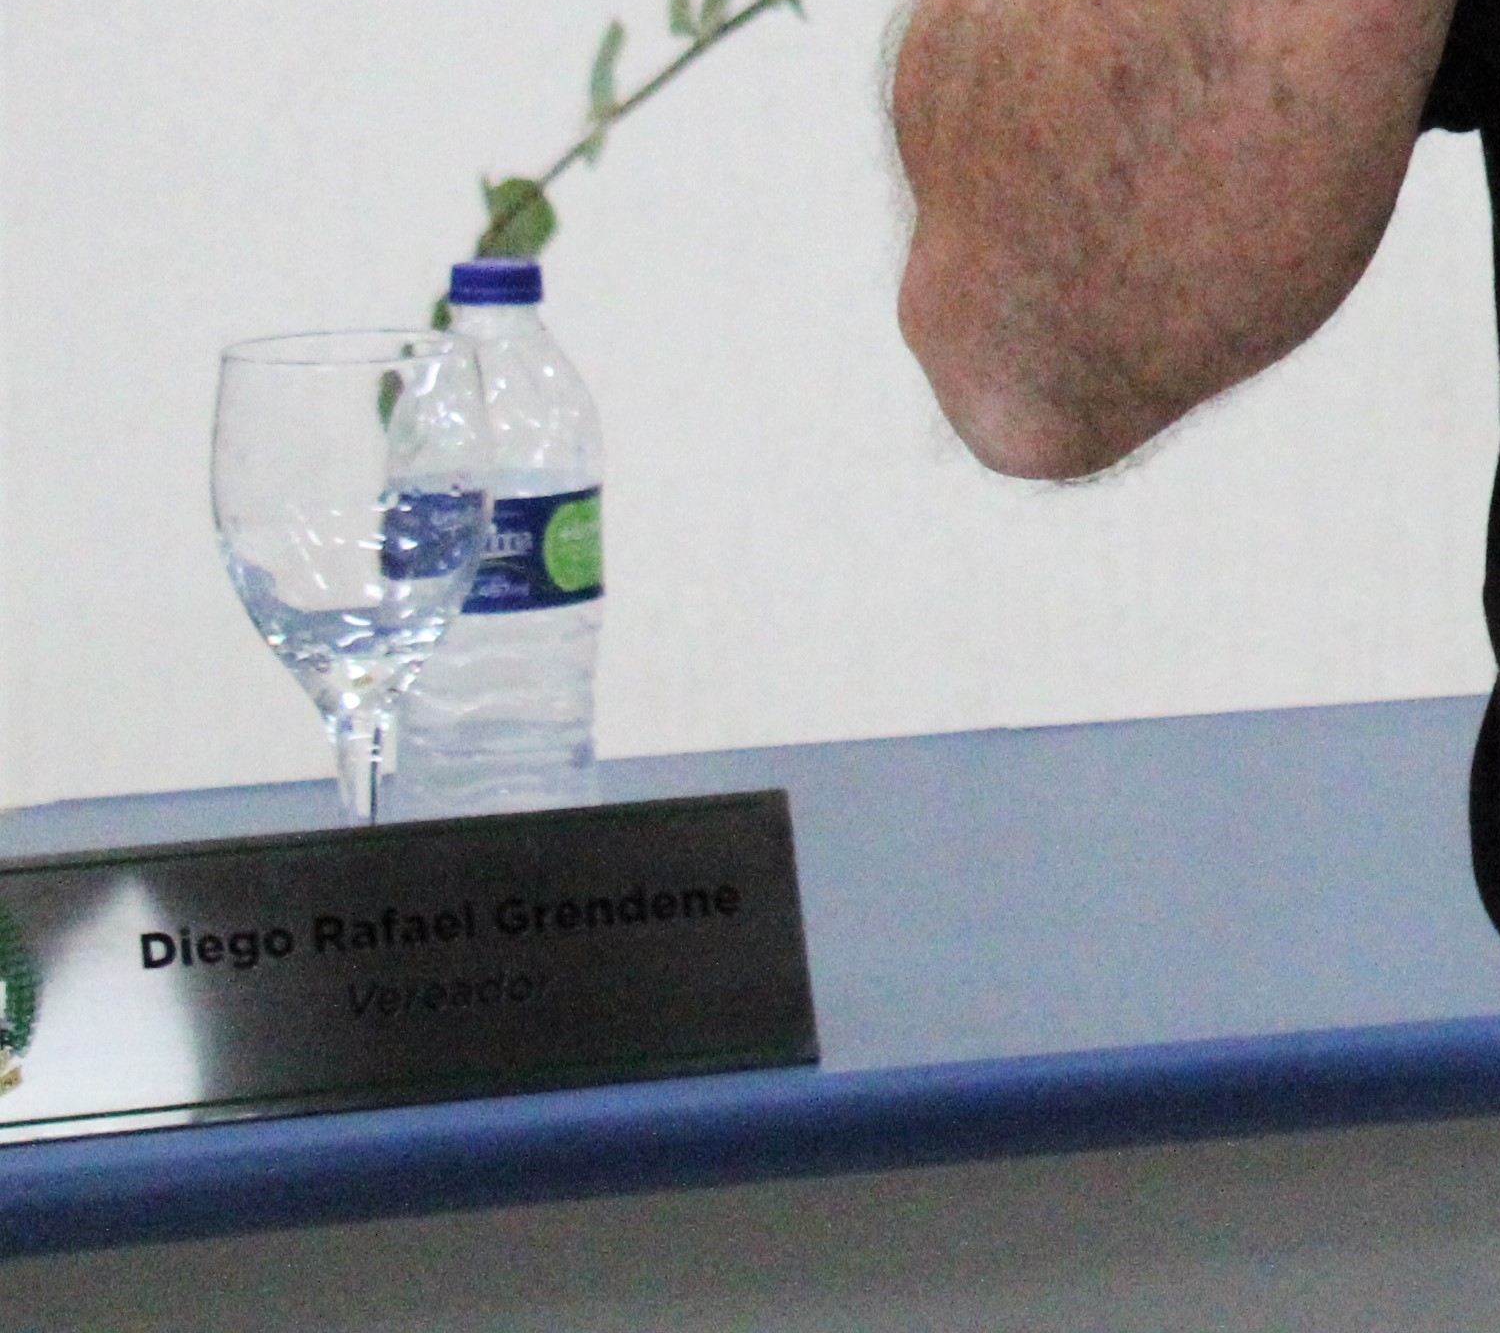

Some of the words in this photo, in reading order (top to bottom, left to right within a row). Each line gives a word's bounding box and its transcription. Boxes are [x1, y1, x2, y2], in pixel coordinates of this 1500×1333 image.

[140, 924, 294, 971] Diego
[312, 902, 475, 955] Rafael
[497, 882, 741, 936] Grendene
